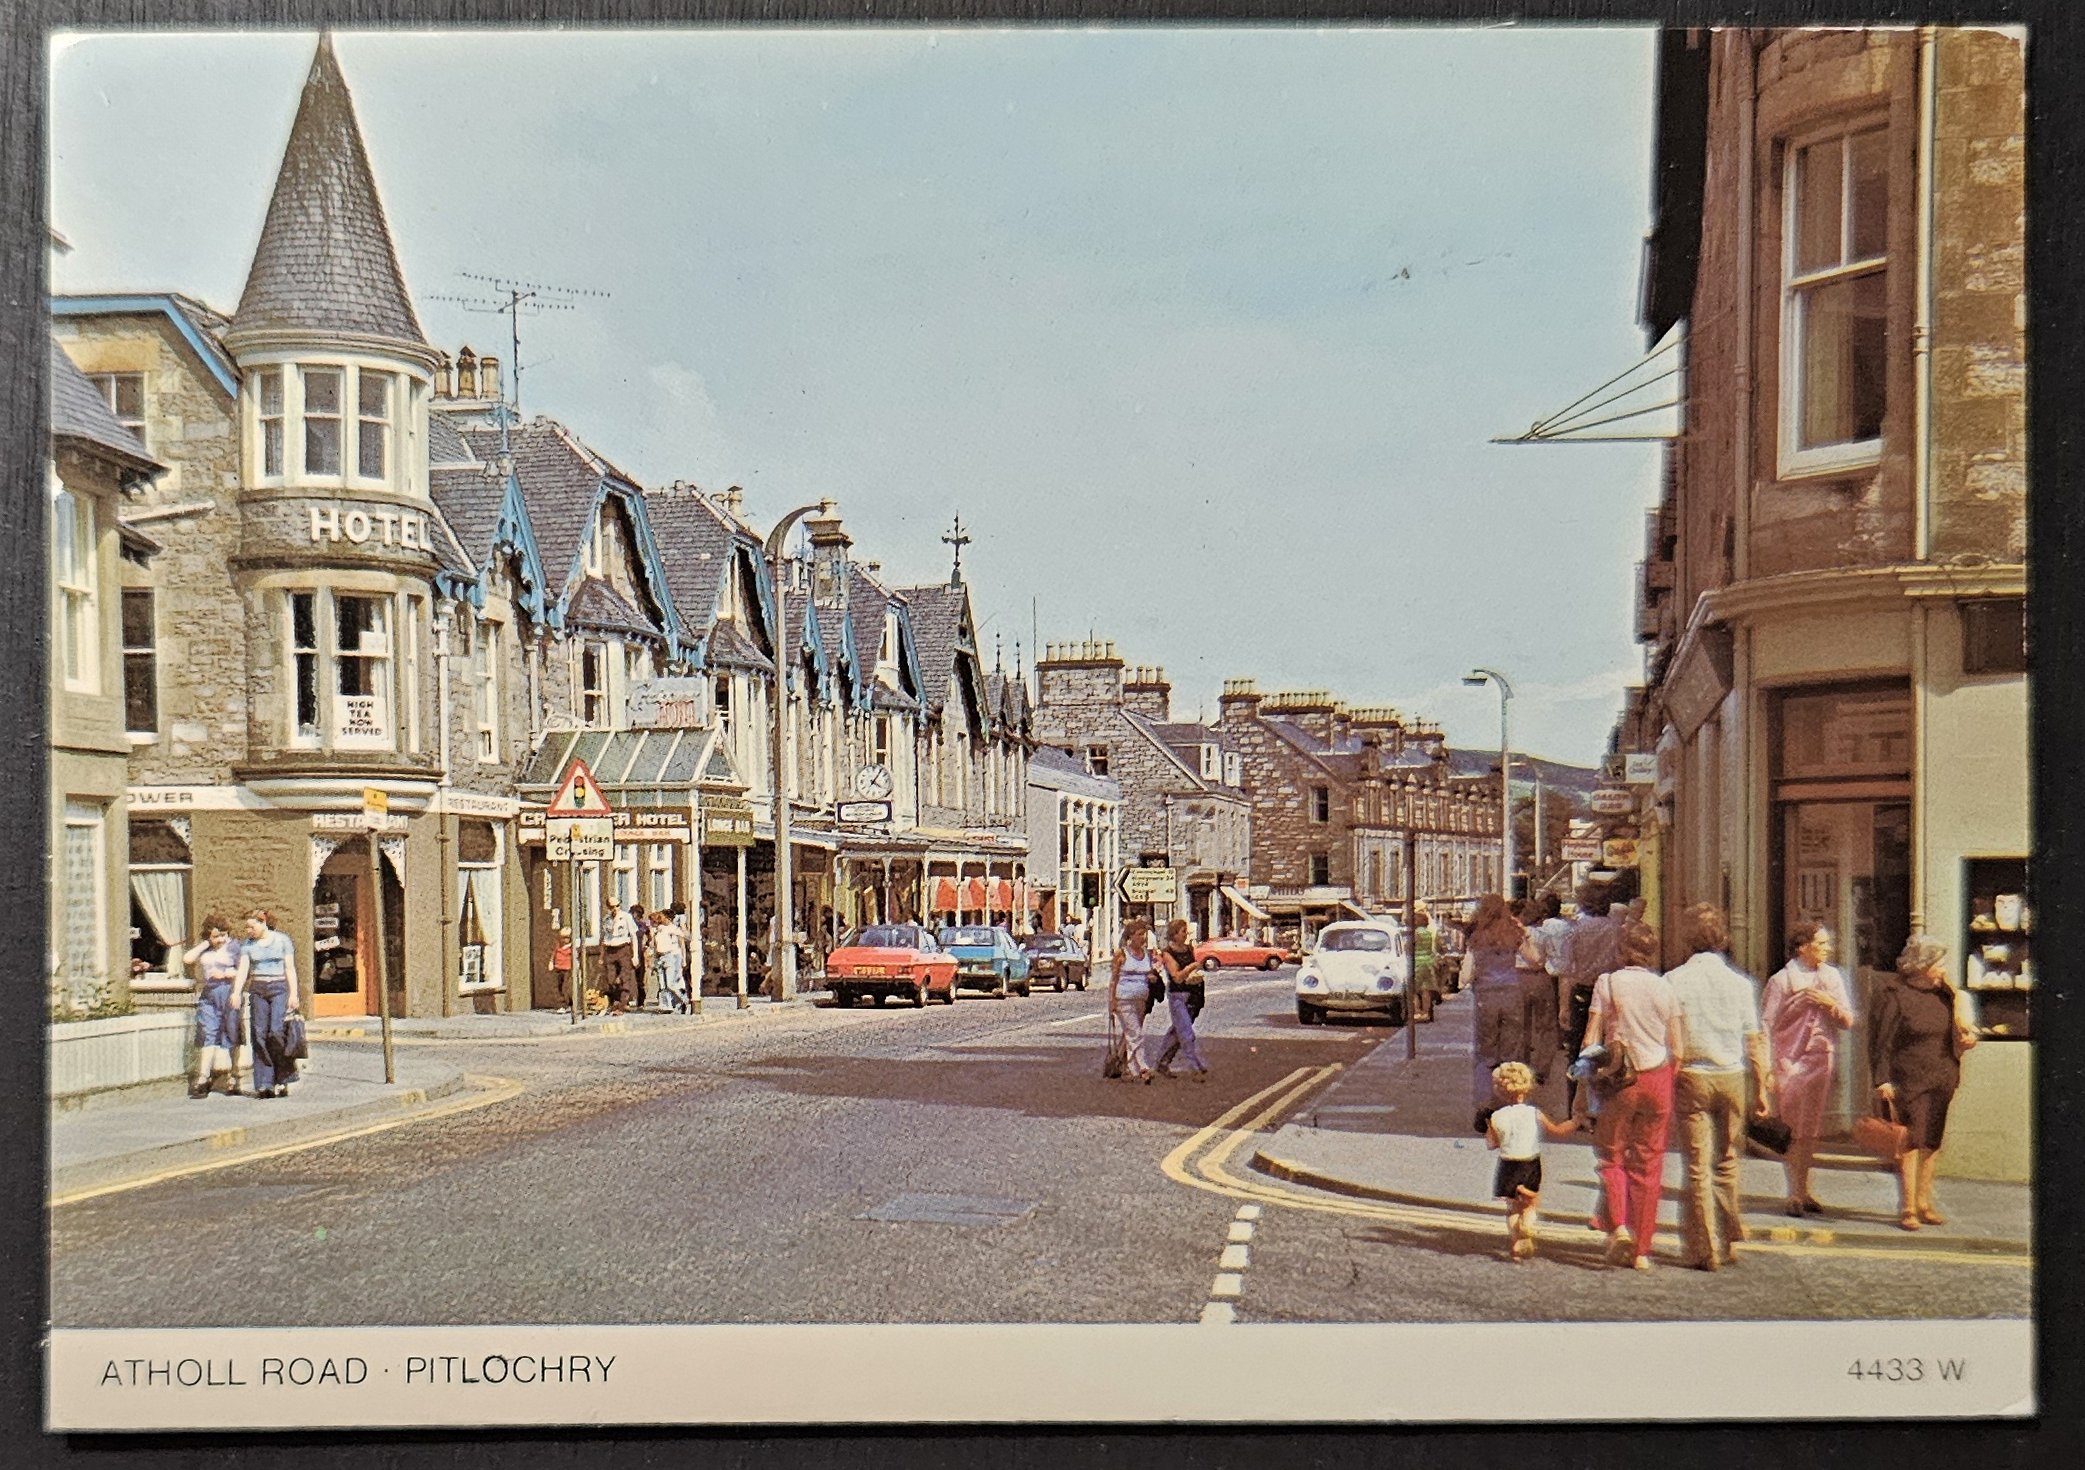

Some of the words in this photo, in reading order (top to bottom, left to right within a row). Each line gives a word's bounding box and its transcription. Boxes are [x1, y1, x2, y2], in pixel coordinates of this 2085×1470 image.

[309, 506, 434, 551] HOTEL
[347, 700, 374, 708] HIGH
[635, 812, 688, 827] HOTEL
[549, 833, 610, 844] Pedstrian
[101, 1358, 247, 1386] ATHOLL
[262, 1357, 368, 1385] ROAD
[406, 1354, 617, 1384] PITLOCHRY
[1846, 1357, 1925, 1381] 4433
[1936, 1358, 1967, 1381] W
